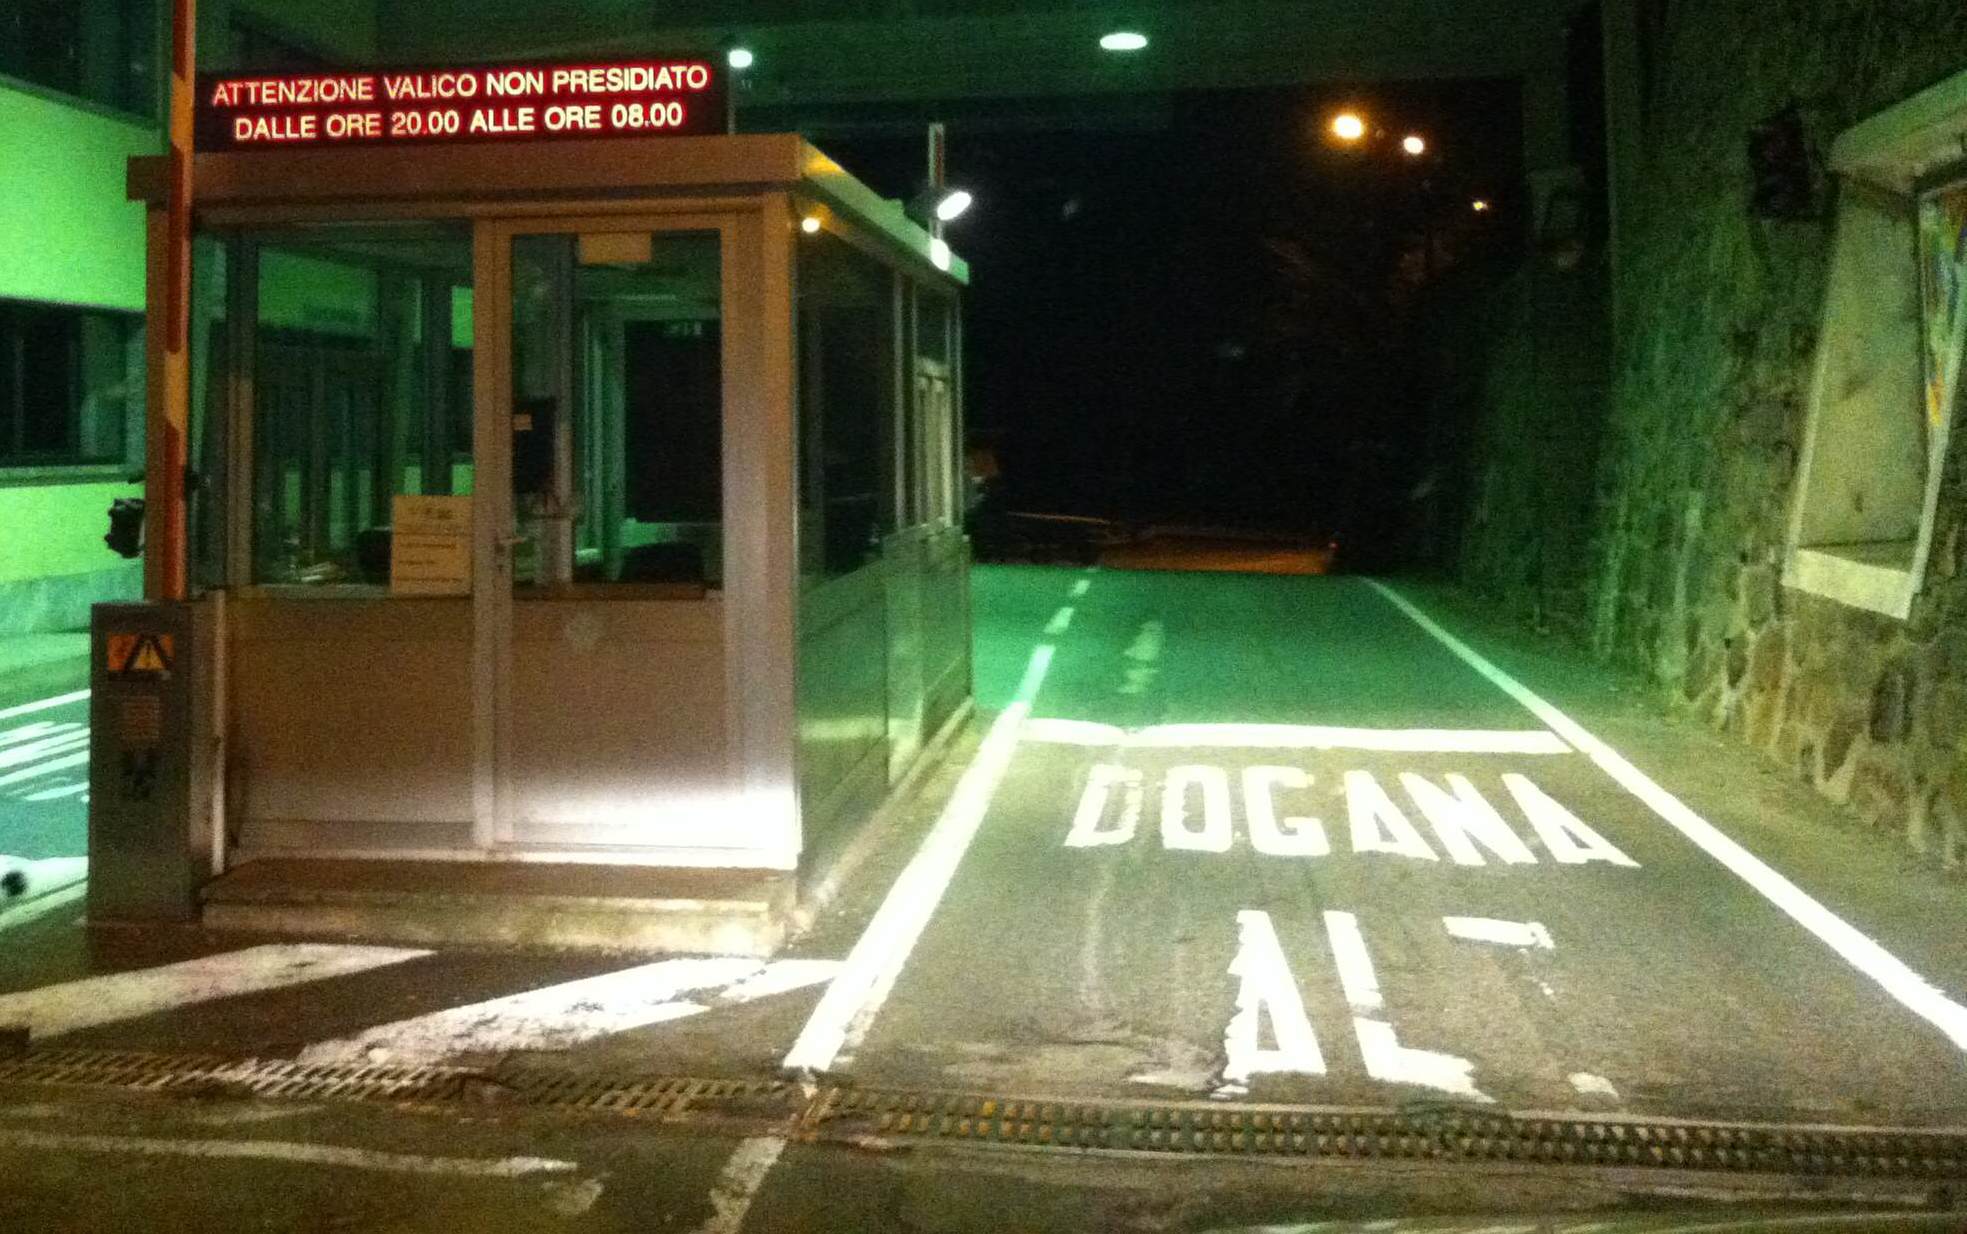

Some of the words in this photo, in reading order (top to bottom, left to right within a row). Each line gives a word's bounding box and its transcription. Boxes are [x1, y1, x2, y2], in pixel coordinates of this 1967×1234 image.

[213, 77, 374, 106] ATTENZIONE
[384, 73, 478, 99] VALICO
[486, 71, 544, 96] NON
[552, 65, 708, 94] PRESIDIATO
[234, 115, 317, 141] DALLE
[325, 112, 382, 138] ORE
[391, 109, 459, 135] 20.00
[469, 108, 535, 133] ALLE
[543, 105, 602, 131] ORE
[611, 102, 683, 128] 08.00
[1063, 763, 1642, 868] DOGANA
